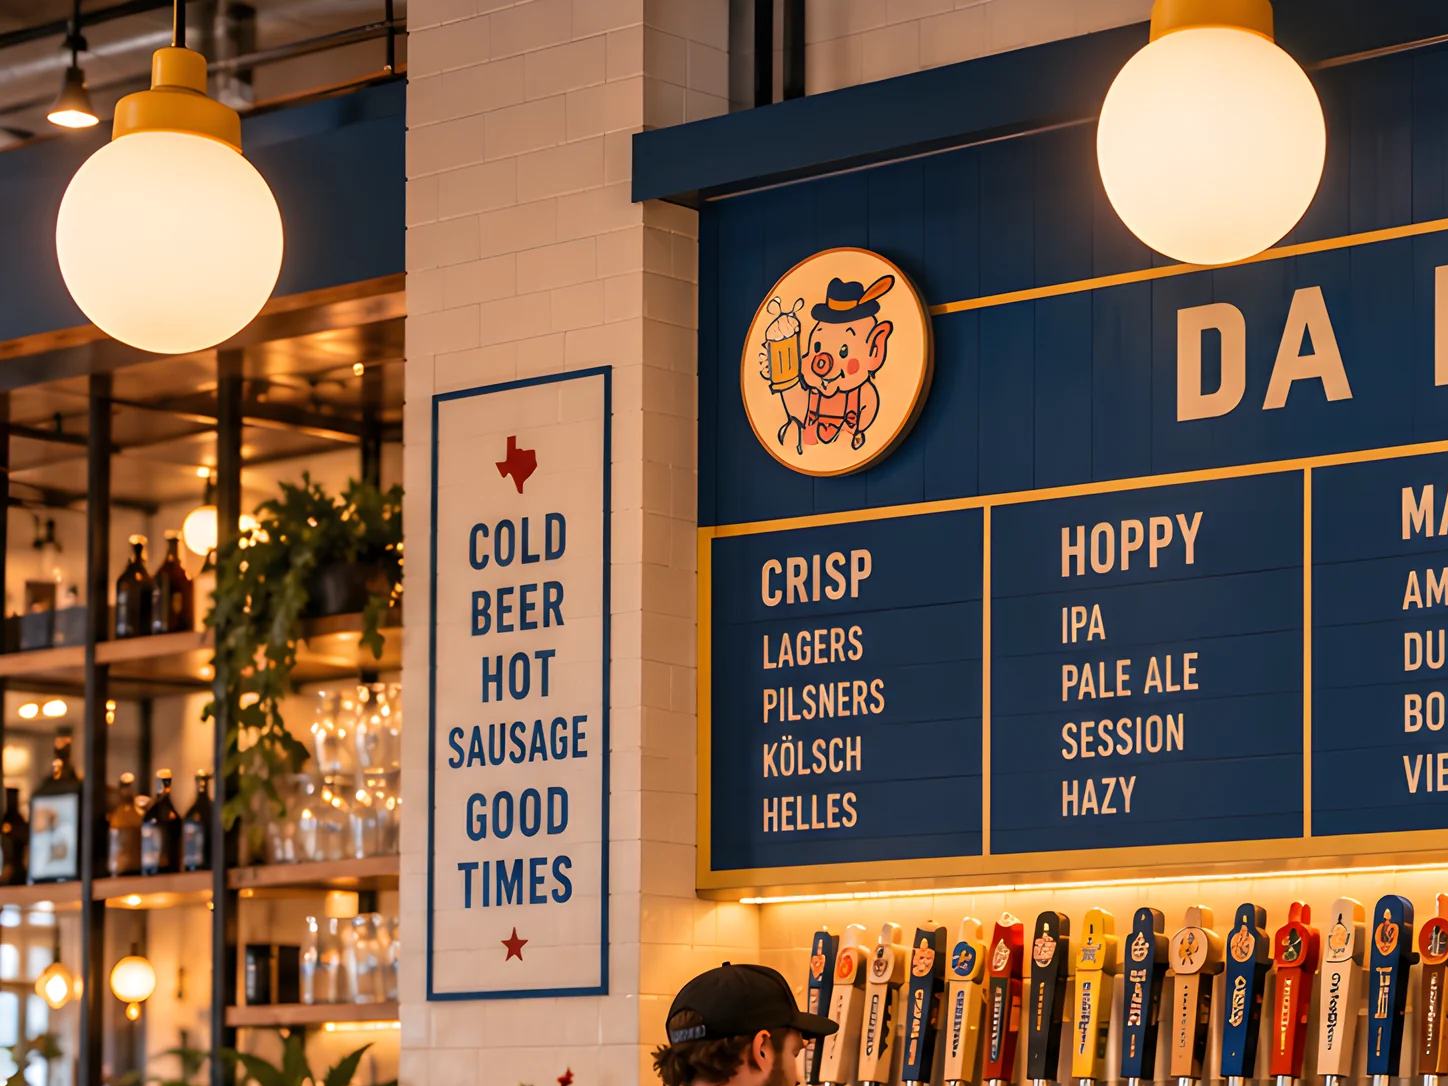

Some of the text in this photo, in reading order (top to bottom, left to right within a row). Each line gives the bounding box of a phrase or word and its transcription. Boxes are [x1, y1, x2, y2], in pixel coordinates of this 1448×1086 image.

[1177, 286, 1352, 421] DA
[469, 513, 566, 570] COLD
[1062, 512, 1203, 577] HOPPY
[762, 549, 871, 606] CRISP
[472, 581, 564, 636] BEER
[1063, 604, 1105, 643] IPA
[764, 626, 863, 669] LAGERS
[482, 649, 555, 702] HOT
[764, 679, 884, 723] PILSNERS
[1063, 653, 1198, 701] PALE ALE
[449, 715, 587, 768] SAUSAGE
[764, 736, 861, 777] KÖLSCH
[1062, 714, 1183, 759] SESSION
[467, 787, 568, 841] GOOD
[764, 792, 857, 832] HELLES
[1063, 776, 1136, 816] HAZY
[458, 855, 572, 908] TIMES
